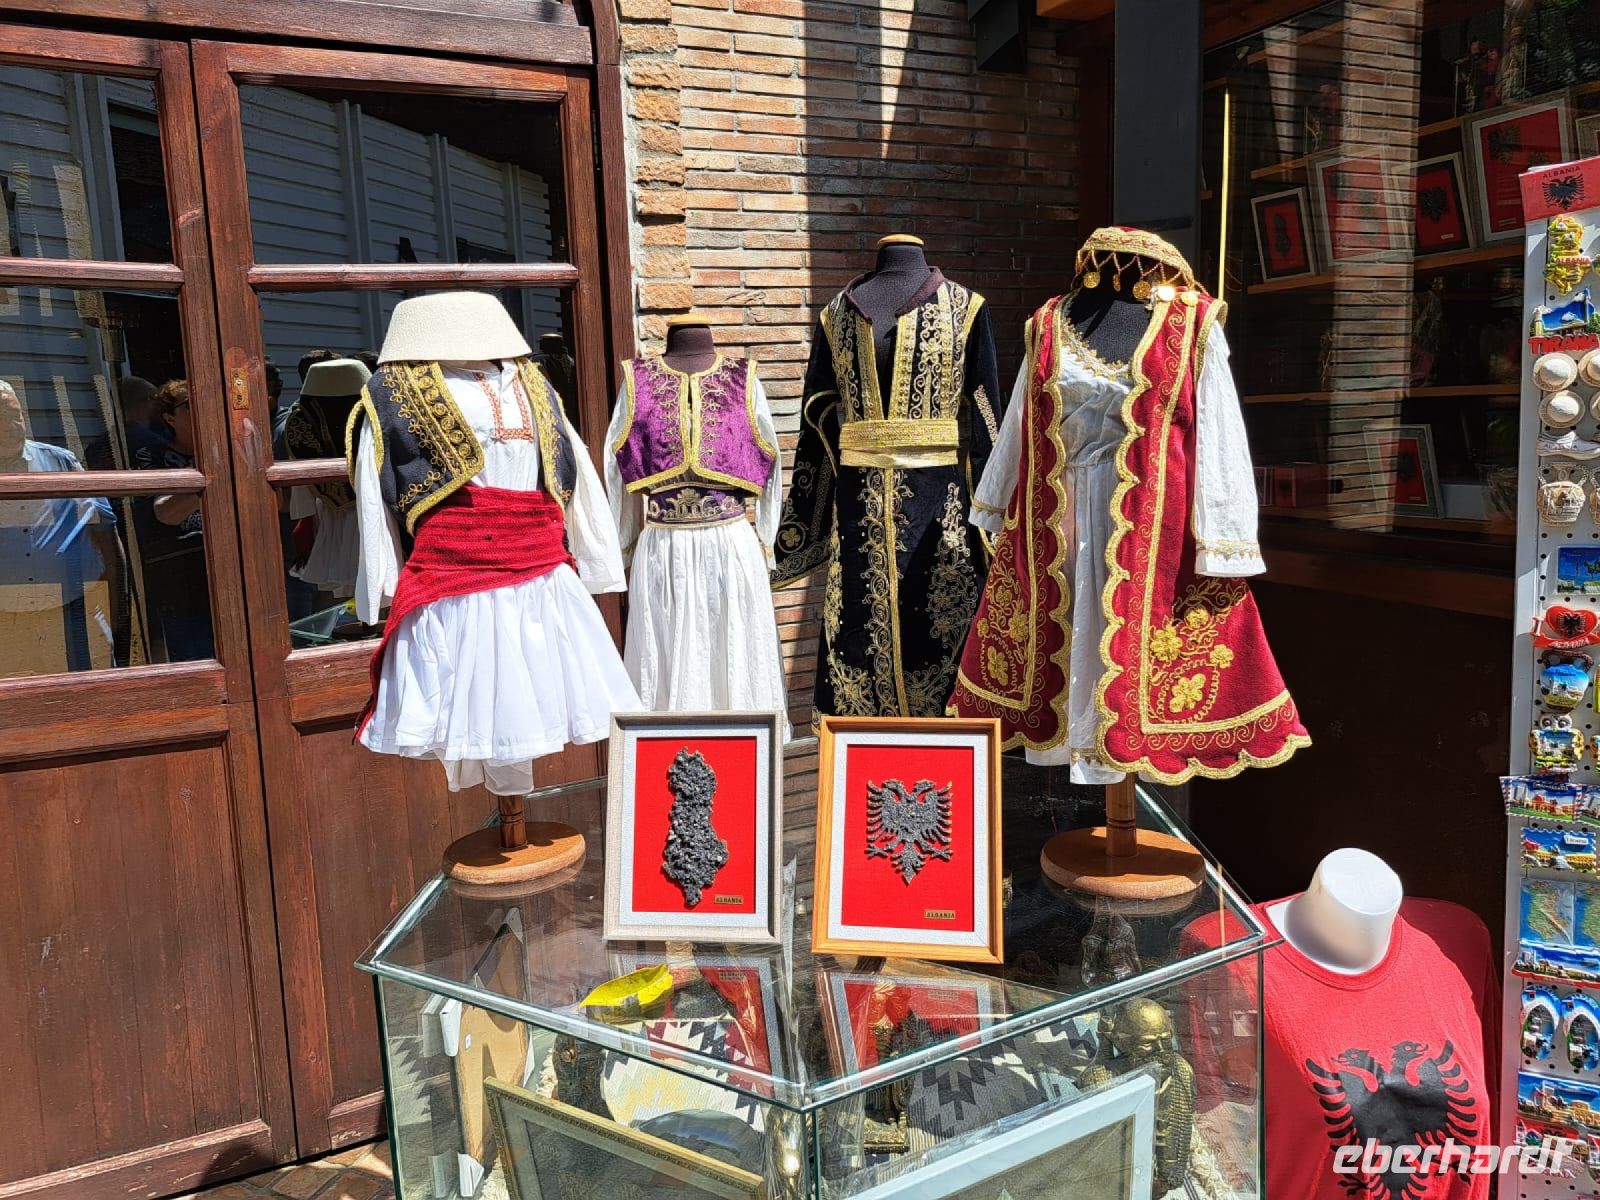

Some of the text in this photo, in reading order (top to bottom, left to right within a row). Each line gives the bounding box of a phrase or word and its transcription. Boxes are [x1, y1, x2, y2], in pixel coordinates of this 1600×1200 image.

[1543, 166, 1581, 178] ALBANIA
[1555, 256, 1591, 266] ALBANIA
[1528, 334, 1600, 354] TIRANA
[715, 896, 742, 904] ALBANIA
[926, 910, 955, 919] ALBANIA
